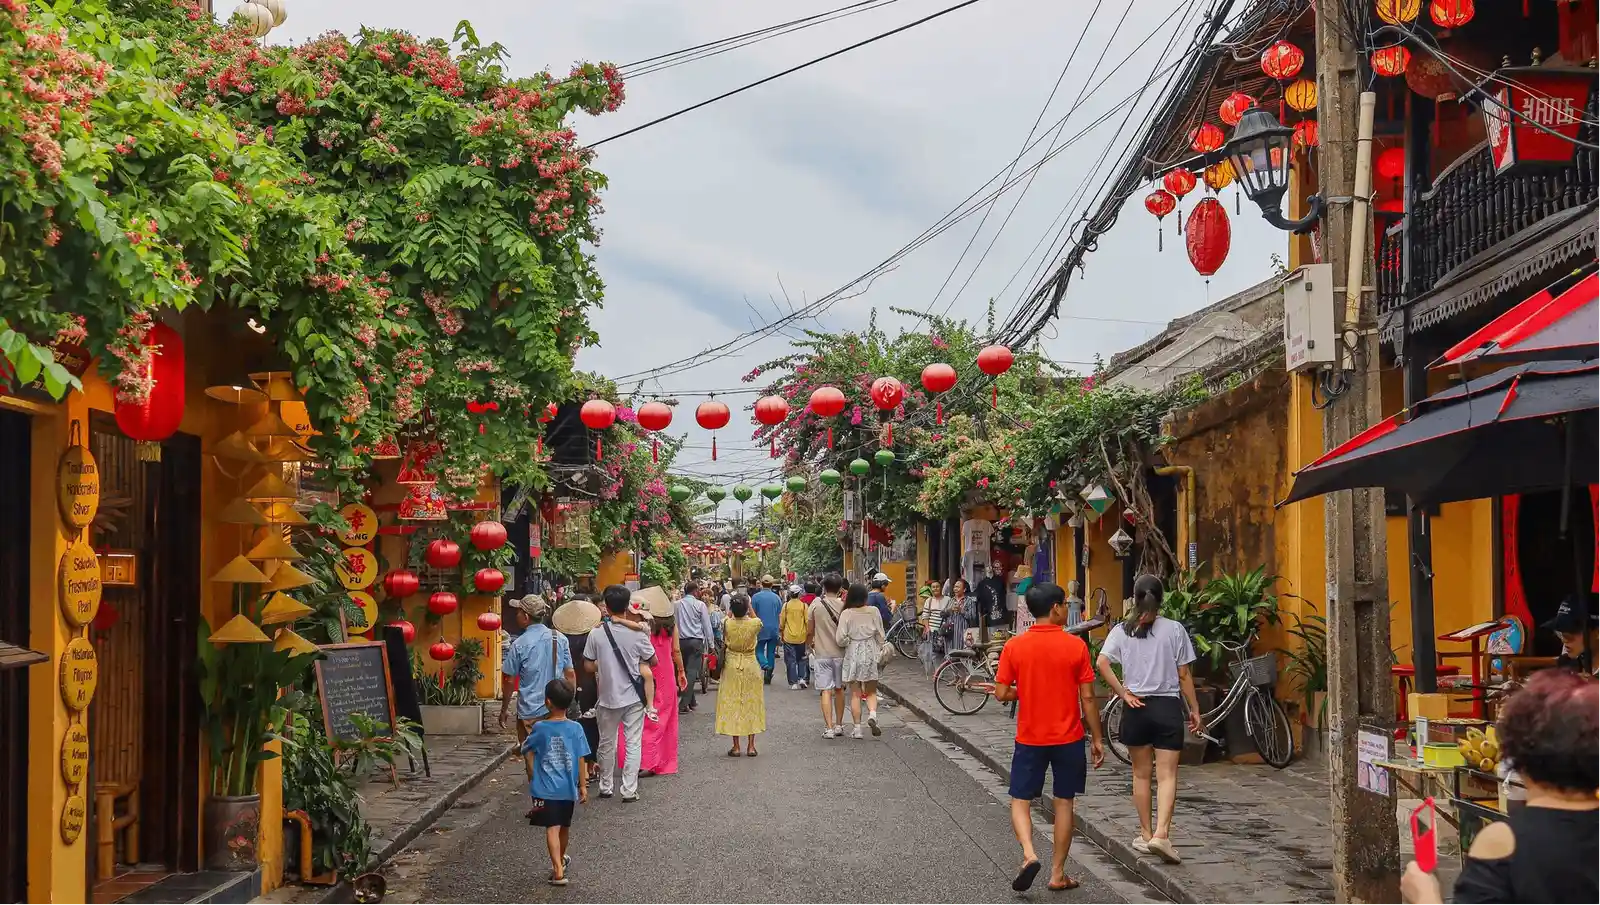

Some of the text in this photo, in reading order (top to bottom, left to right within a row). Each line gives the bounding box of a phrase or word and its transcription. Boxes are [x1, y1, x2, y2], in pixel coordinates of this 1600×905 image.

[73, 502, 91, 516] Silver
[73, 557, 96, 572] Selected
[349, 576, 362, 584] FU
[77, 600, 92, 614] Pearl
[77, 688, 86, 702] Art
